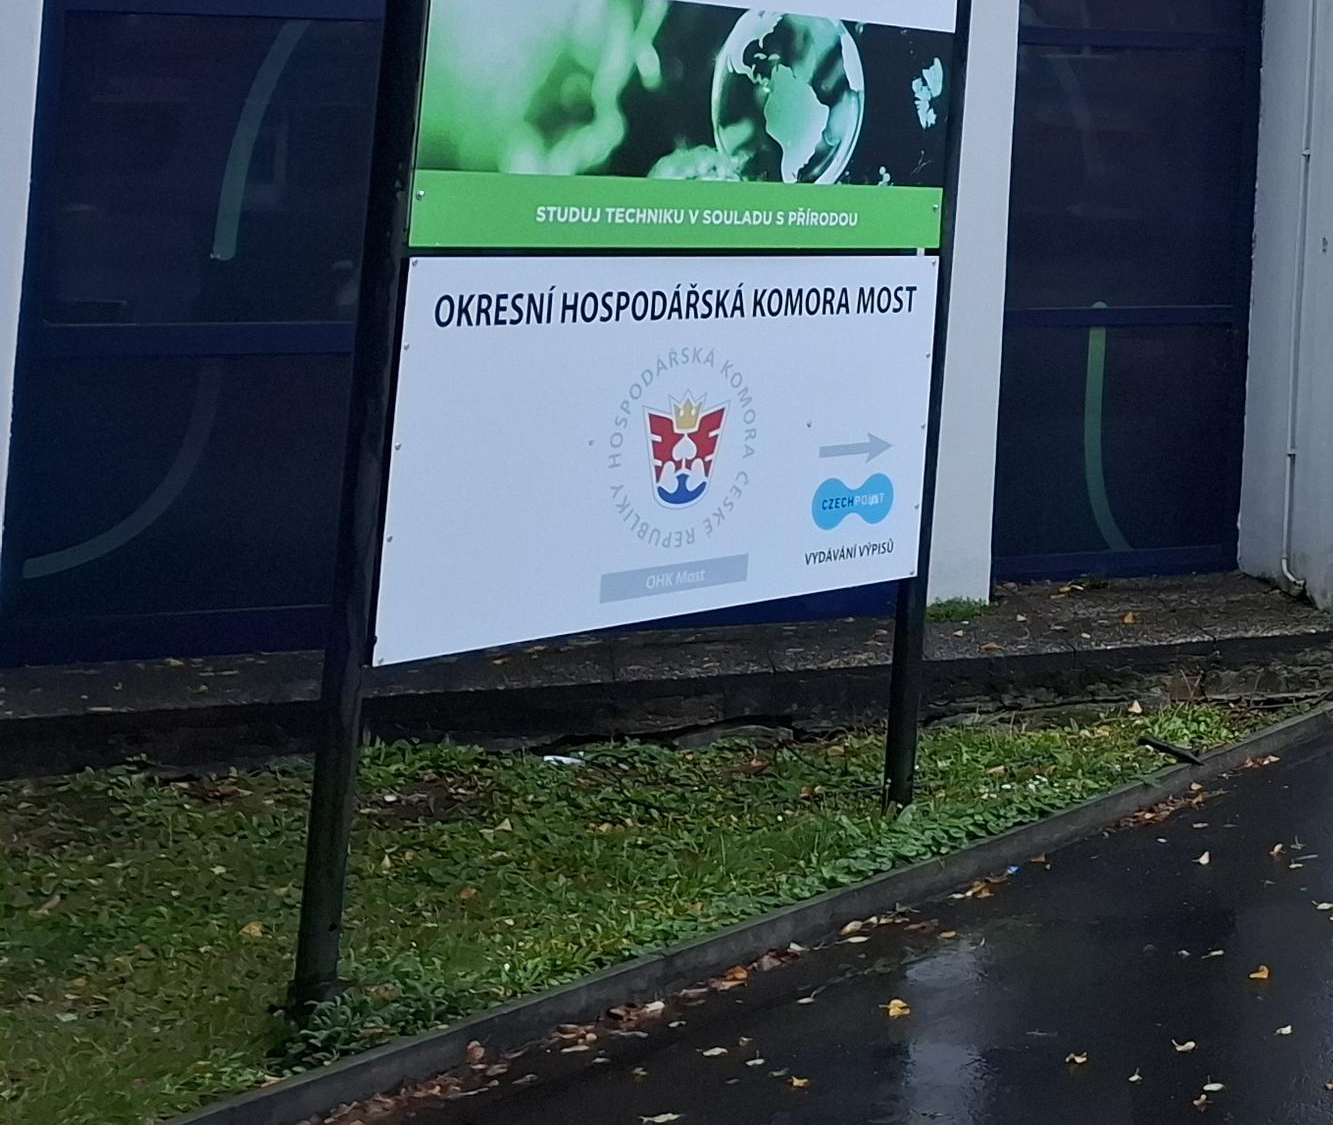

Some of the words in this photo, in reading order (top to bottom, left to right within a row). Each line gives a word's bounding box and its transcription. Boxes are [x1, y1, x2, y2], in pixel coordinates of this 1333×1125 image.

[536, 206, 601, 223] STUDUJ
[605, 208, 684, 224] TECHNIKU
[688, 209, 700, 224] V
[702, 210, 772, 225] SOULADU
[776, 211, 784, 225] S
[788, 207, 858, 226] PŘÍRODOU
[434, 285, 556, 328] OKRESNÍ
[560, 282, 745, 323] HOSPODÁŘSKÁ
[752, 287, 850, 317] KOMORA
[856, 286, 917, 314] MOST
[608, 347, 715, 469] HOSPODÁŘSKÁ
[720, 360, 757, 458] KOMORA
[610, 484, 695, 549] REPUBLIKY
[805, 544, 857, 565] VYDÁVÁNÍ
[859, 537, 894, 557] VÝPISŮ
[646, 571, 673, 589] OHK
[675, 569, 706, 586] Most
